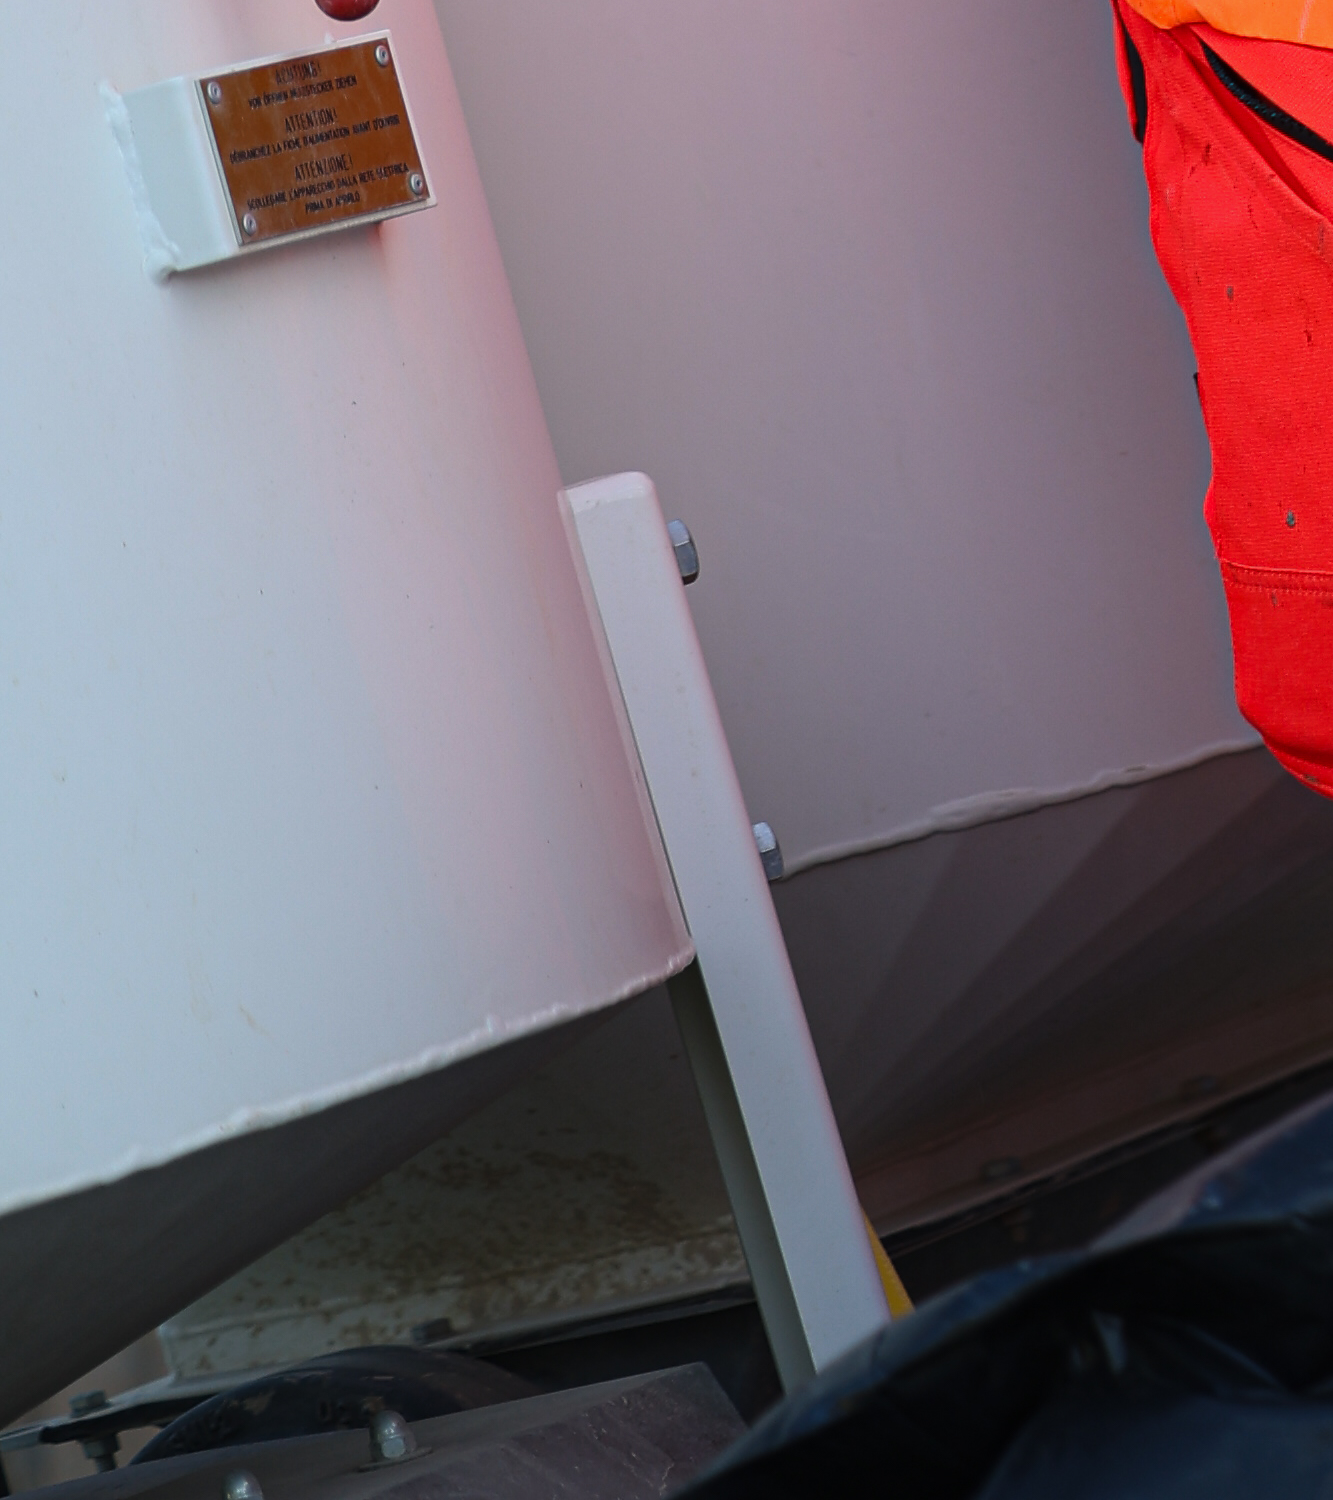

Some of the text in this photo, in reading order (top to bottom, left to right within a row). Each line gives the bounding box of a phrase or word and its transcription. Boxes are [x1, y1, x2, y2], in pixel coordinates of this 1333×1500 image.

[275, 60, 321, 85] ACHTUNG!
[284, 108, 337, 133] ATTENTION!
[272, 143, 281, 153] LA
[294, 155, 353, 180] ATTENZIONE!
